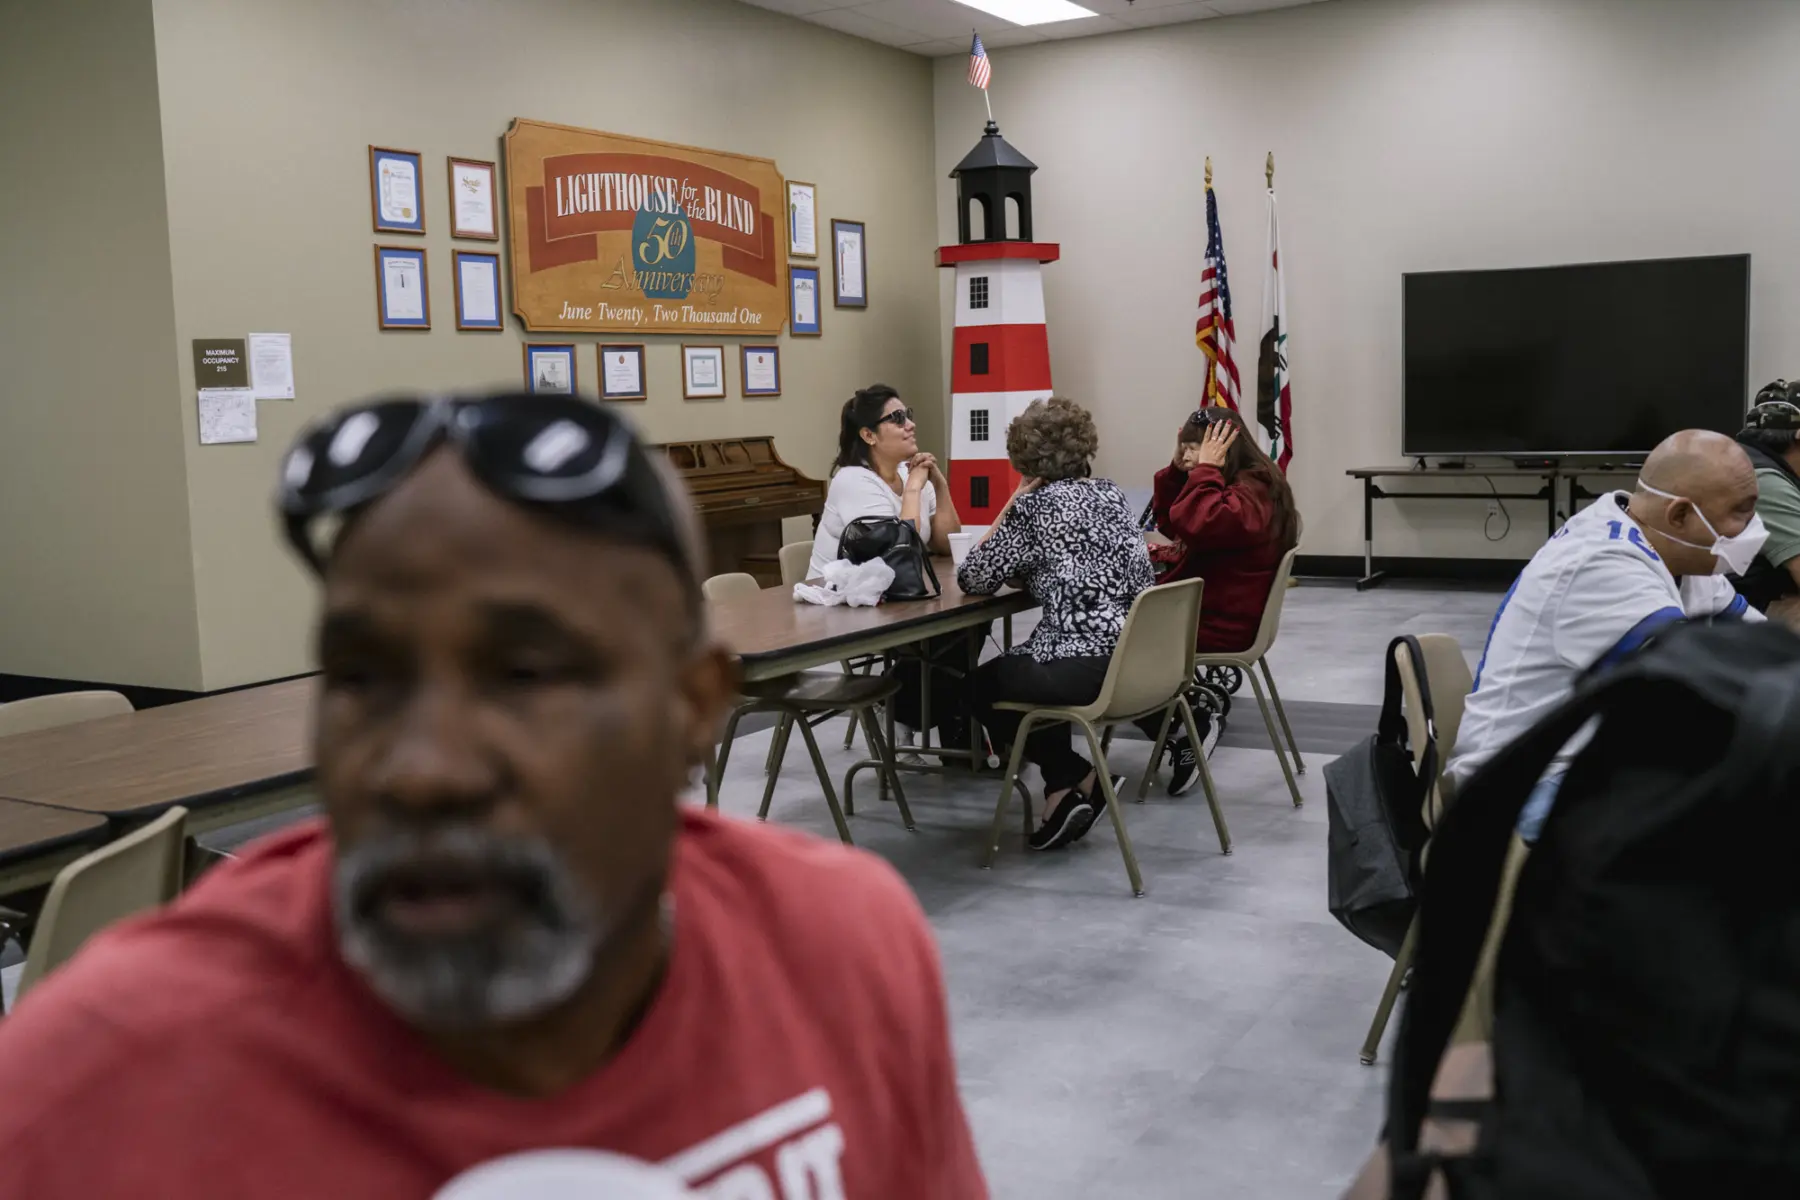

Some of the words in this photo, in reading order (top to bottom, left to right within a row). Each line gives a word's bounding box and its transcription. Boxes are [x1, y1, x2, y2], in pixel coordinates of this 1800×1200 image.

[555, 172, 679, 217] LIGHTHOUSE
[679, 178, 697, 207] for
[687, 199, 706, 221] the
[704, 185, 754, 236] BLIND
[601, 254, 725, 304] Anniversary
[559, 301, 592, 320] June
[597, 302, 648, 326] Twenty,
[653, 304, 678, 322] Two
[681, 305, 737, 323] Thousand
[739, 307, 762, 324] One
[202, 357, 240, 365] OCCUPANCY
